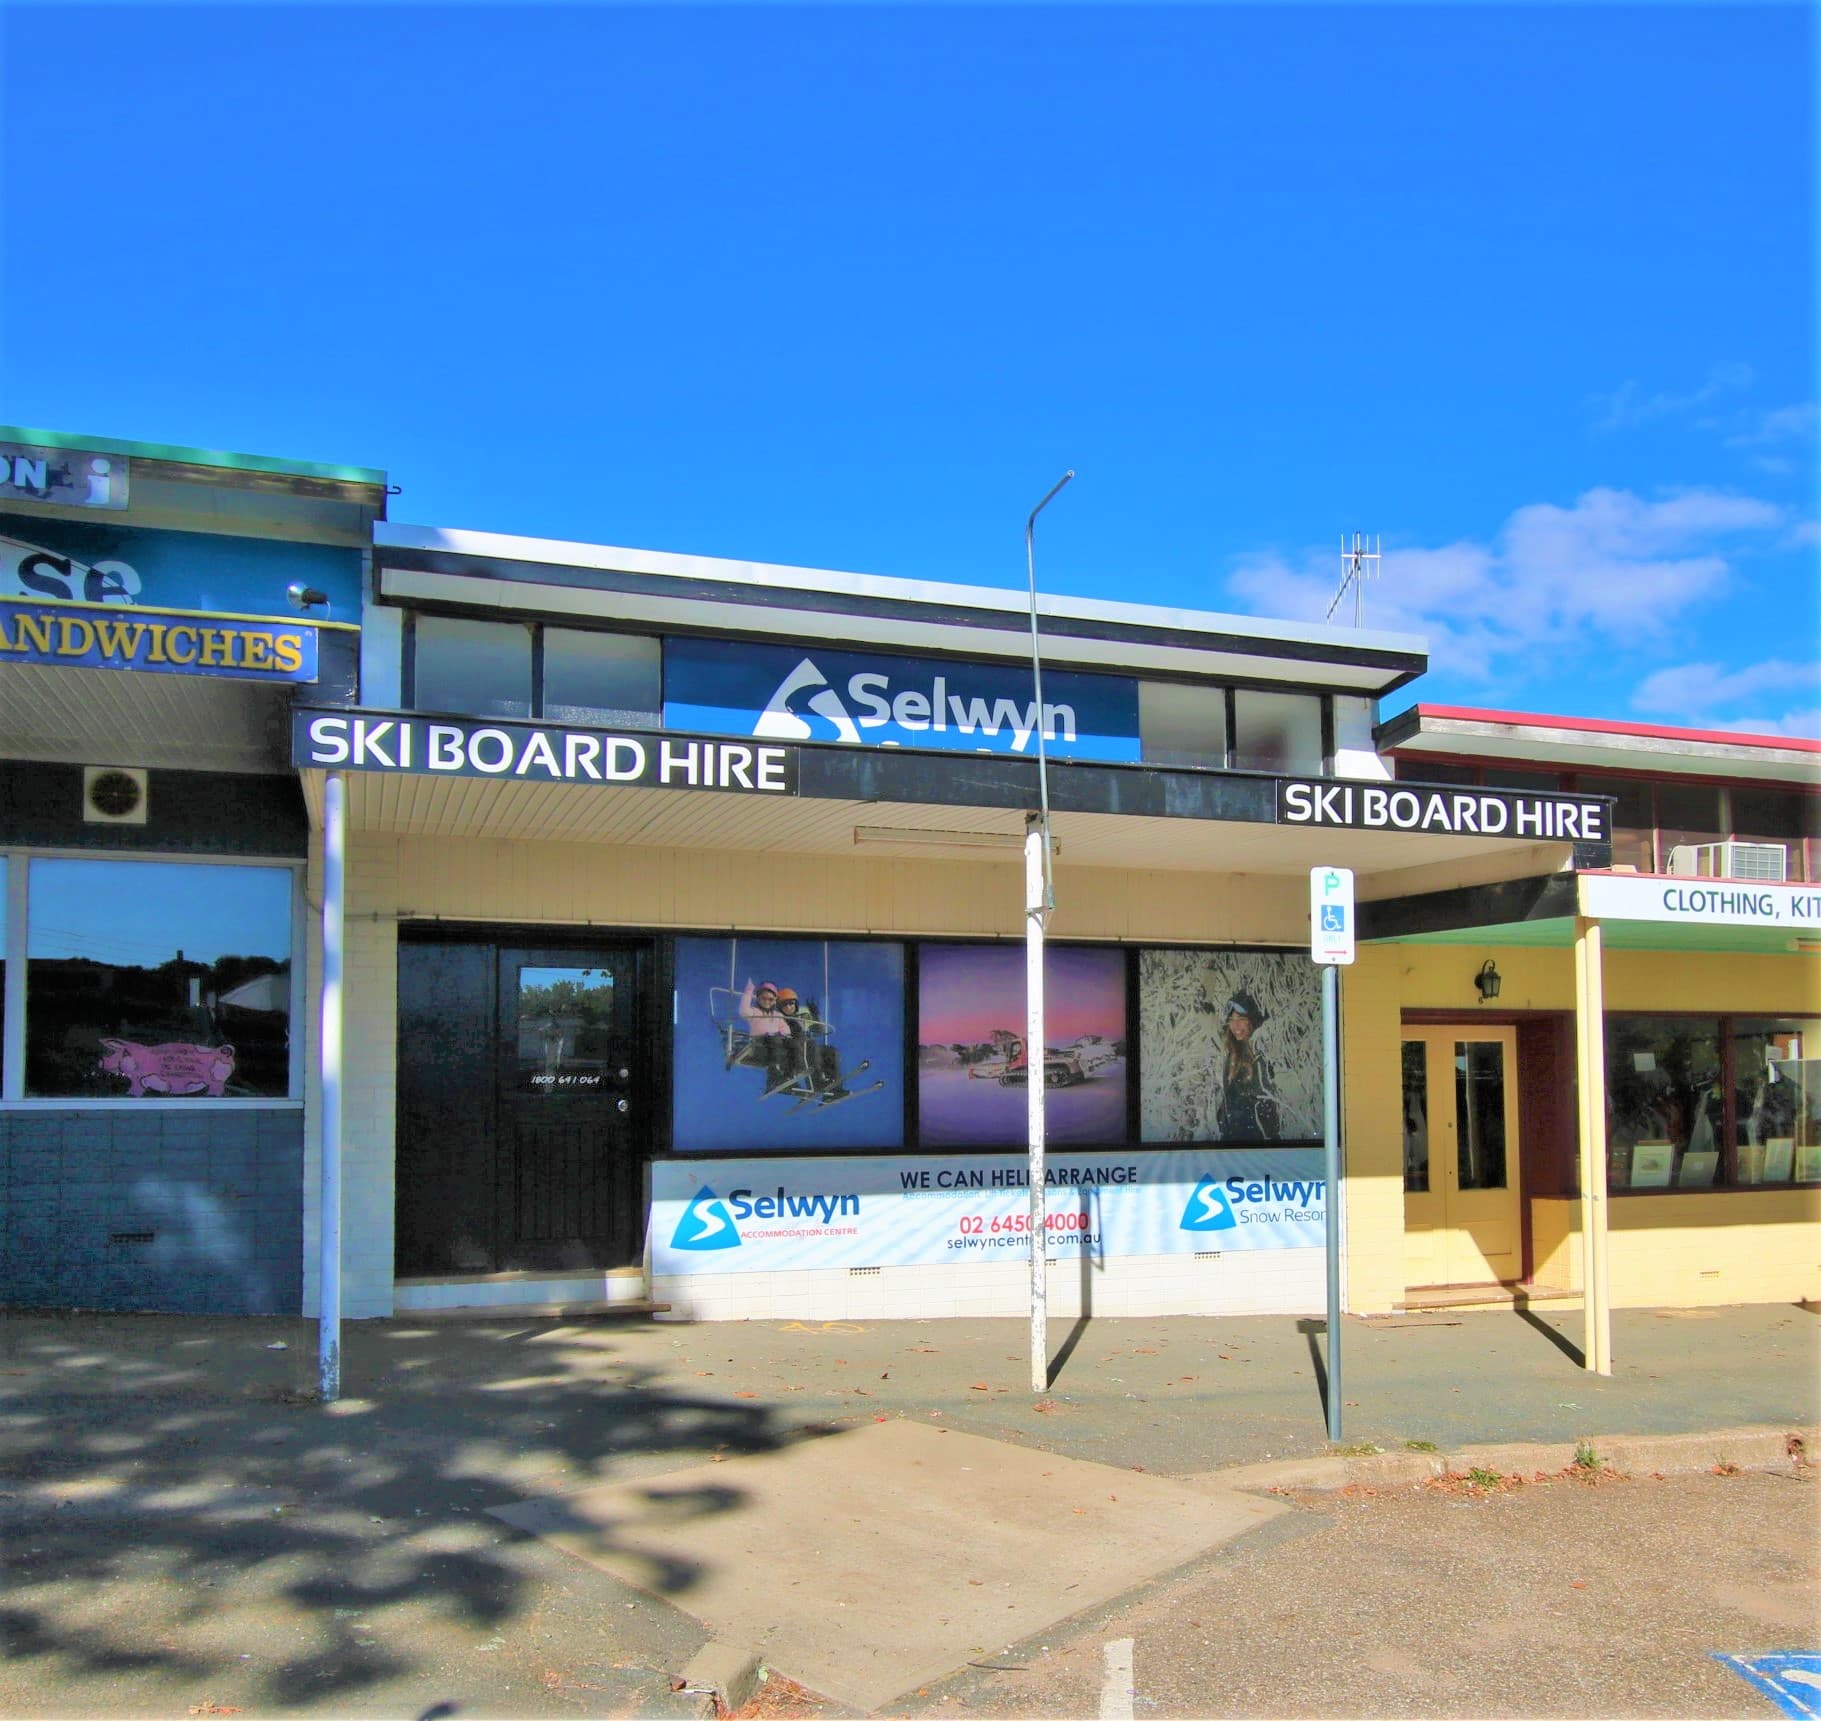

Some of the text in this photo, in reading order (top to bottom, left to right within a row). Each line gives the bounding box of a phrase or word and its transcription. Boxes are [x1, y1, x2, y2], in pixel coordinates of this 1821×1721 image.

[847, 672, 1076, 753] Selwyn
[309, 717, 787, 791] SKI BOARD HIRE
[1285, 783, 1603, 840] SKI BOARD HIRE
[1325, 874, 1340, 896] P
[1663, 888, 1780, 919] CLOTHING,
[531, 1075, 556, 1084] 1800
[900, 1171, 930, 1189] WE
[937, 1170, 984, 1188] CAN
[1044, 1166, 1137, 1185] ARRANGE
[728, 1186, 860, 1225] Selwyn
[1240, 1209, 1281, 1224] Snow
[741, 1227, 859, 1239] ACCOMMODATION CENTRE
[959, 1216, 983, 1234] 02
[1043, 1213, 1089, 1231] 4000
